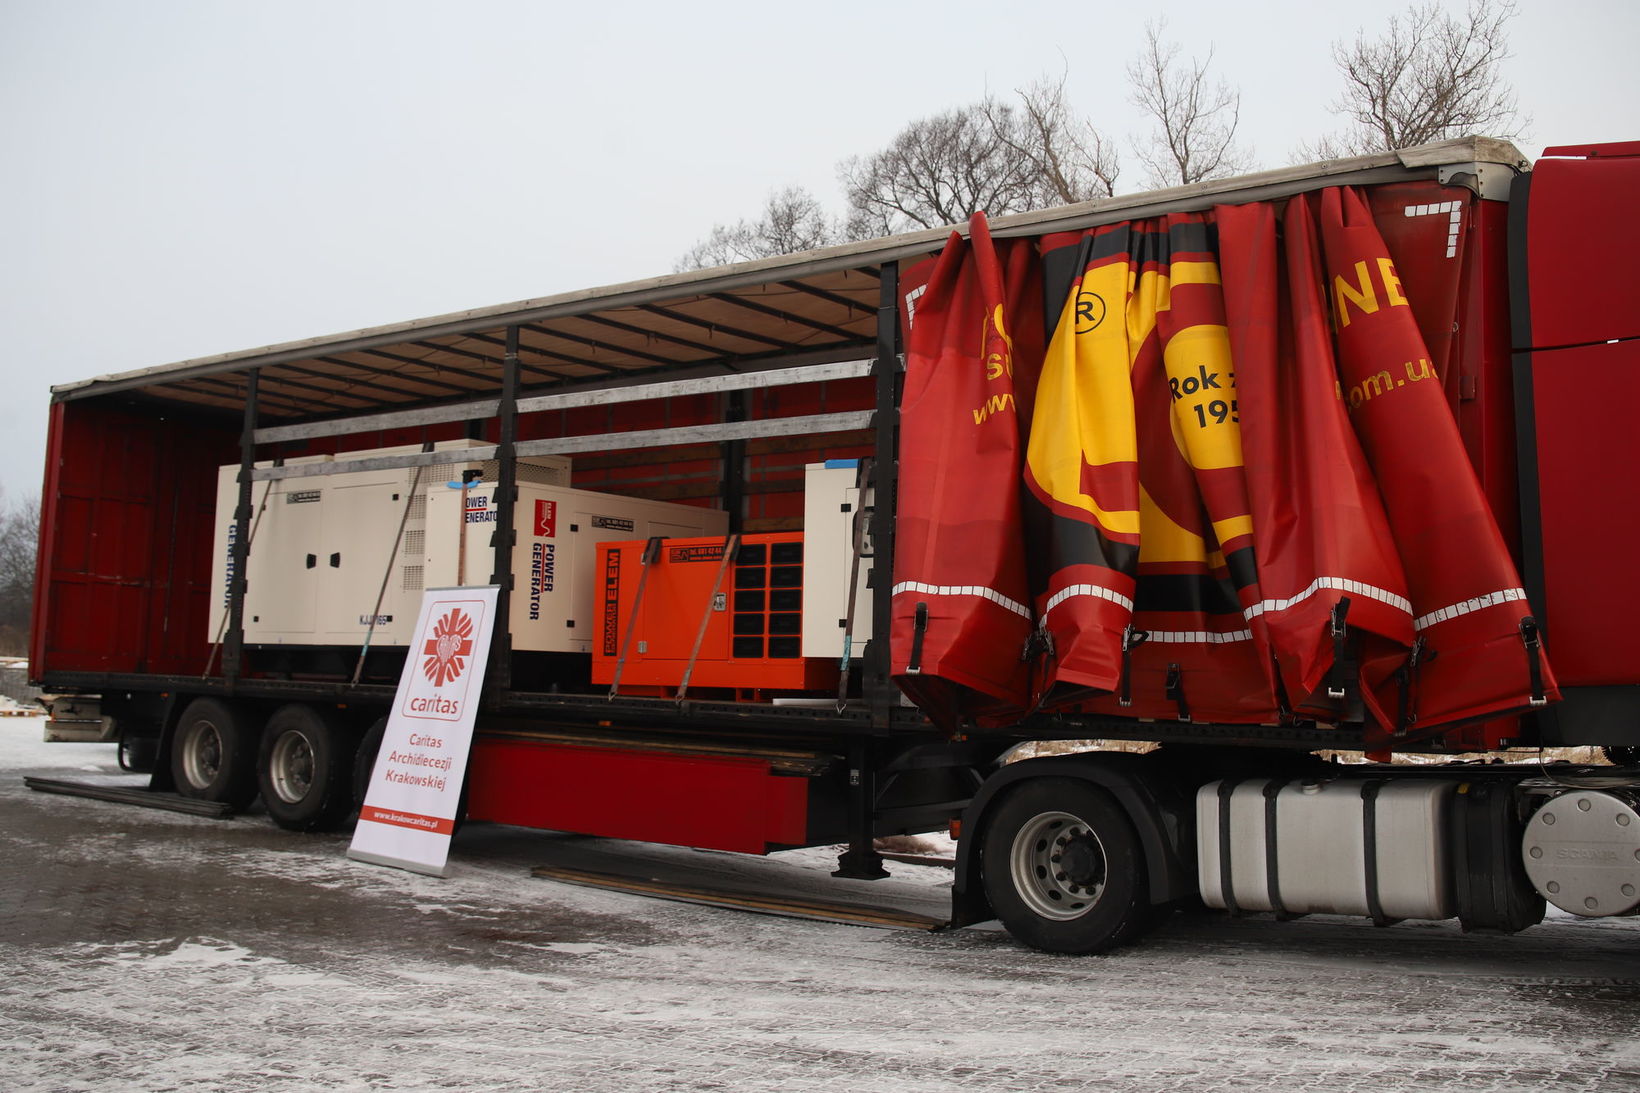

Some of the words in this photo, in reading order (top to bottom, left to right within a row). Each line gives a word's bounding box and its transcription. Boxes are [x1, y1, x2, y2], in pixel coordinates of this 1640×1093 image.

[1169, 365, 1221, 403] Rok
[465, 496, 488, 508] OWER
[465, 511, 497, 523] ENERATO
[544, 544, 556, 592] POWER
[607, 552, 620, 600] ELEM
[529, 542, 542, 621] GENERATOR
[410, 693, 459, 714] caritas
[409, 733, 443, 749] Caritas
[388, 750, 452, 772] Archidiecezji
[385, 769, 447, 792] Krakowskiej
